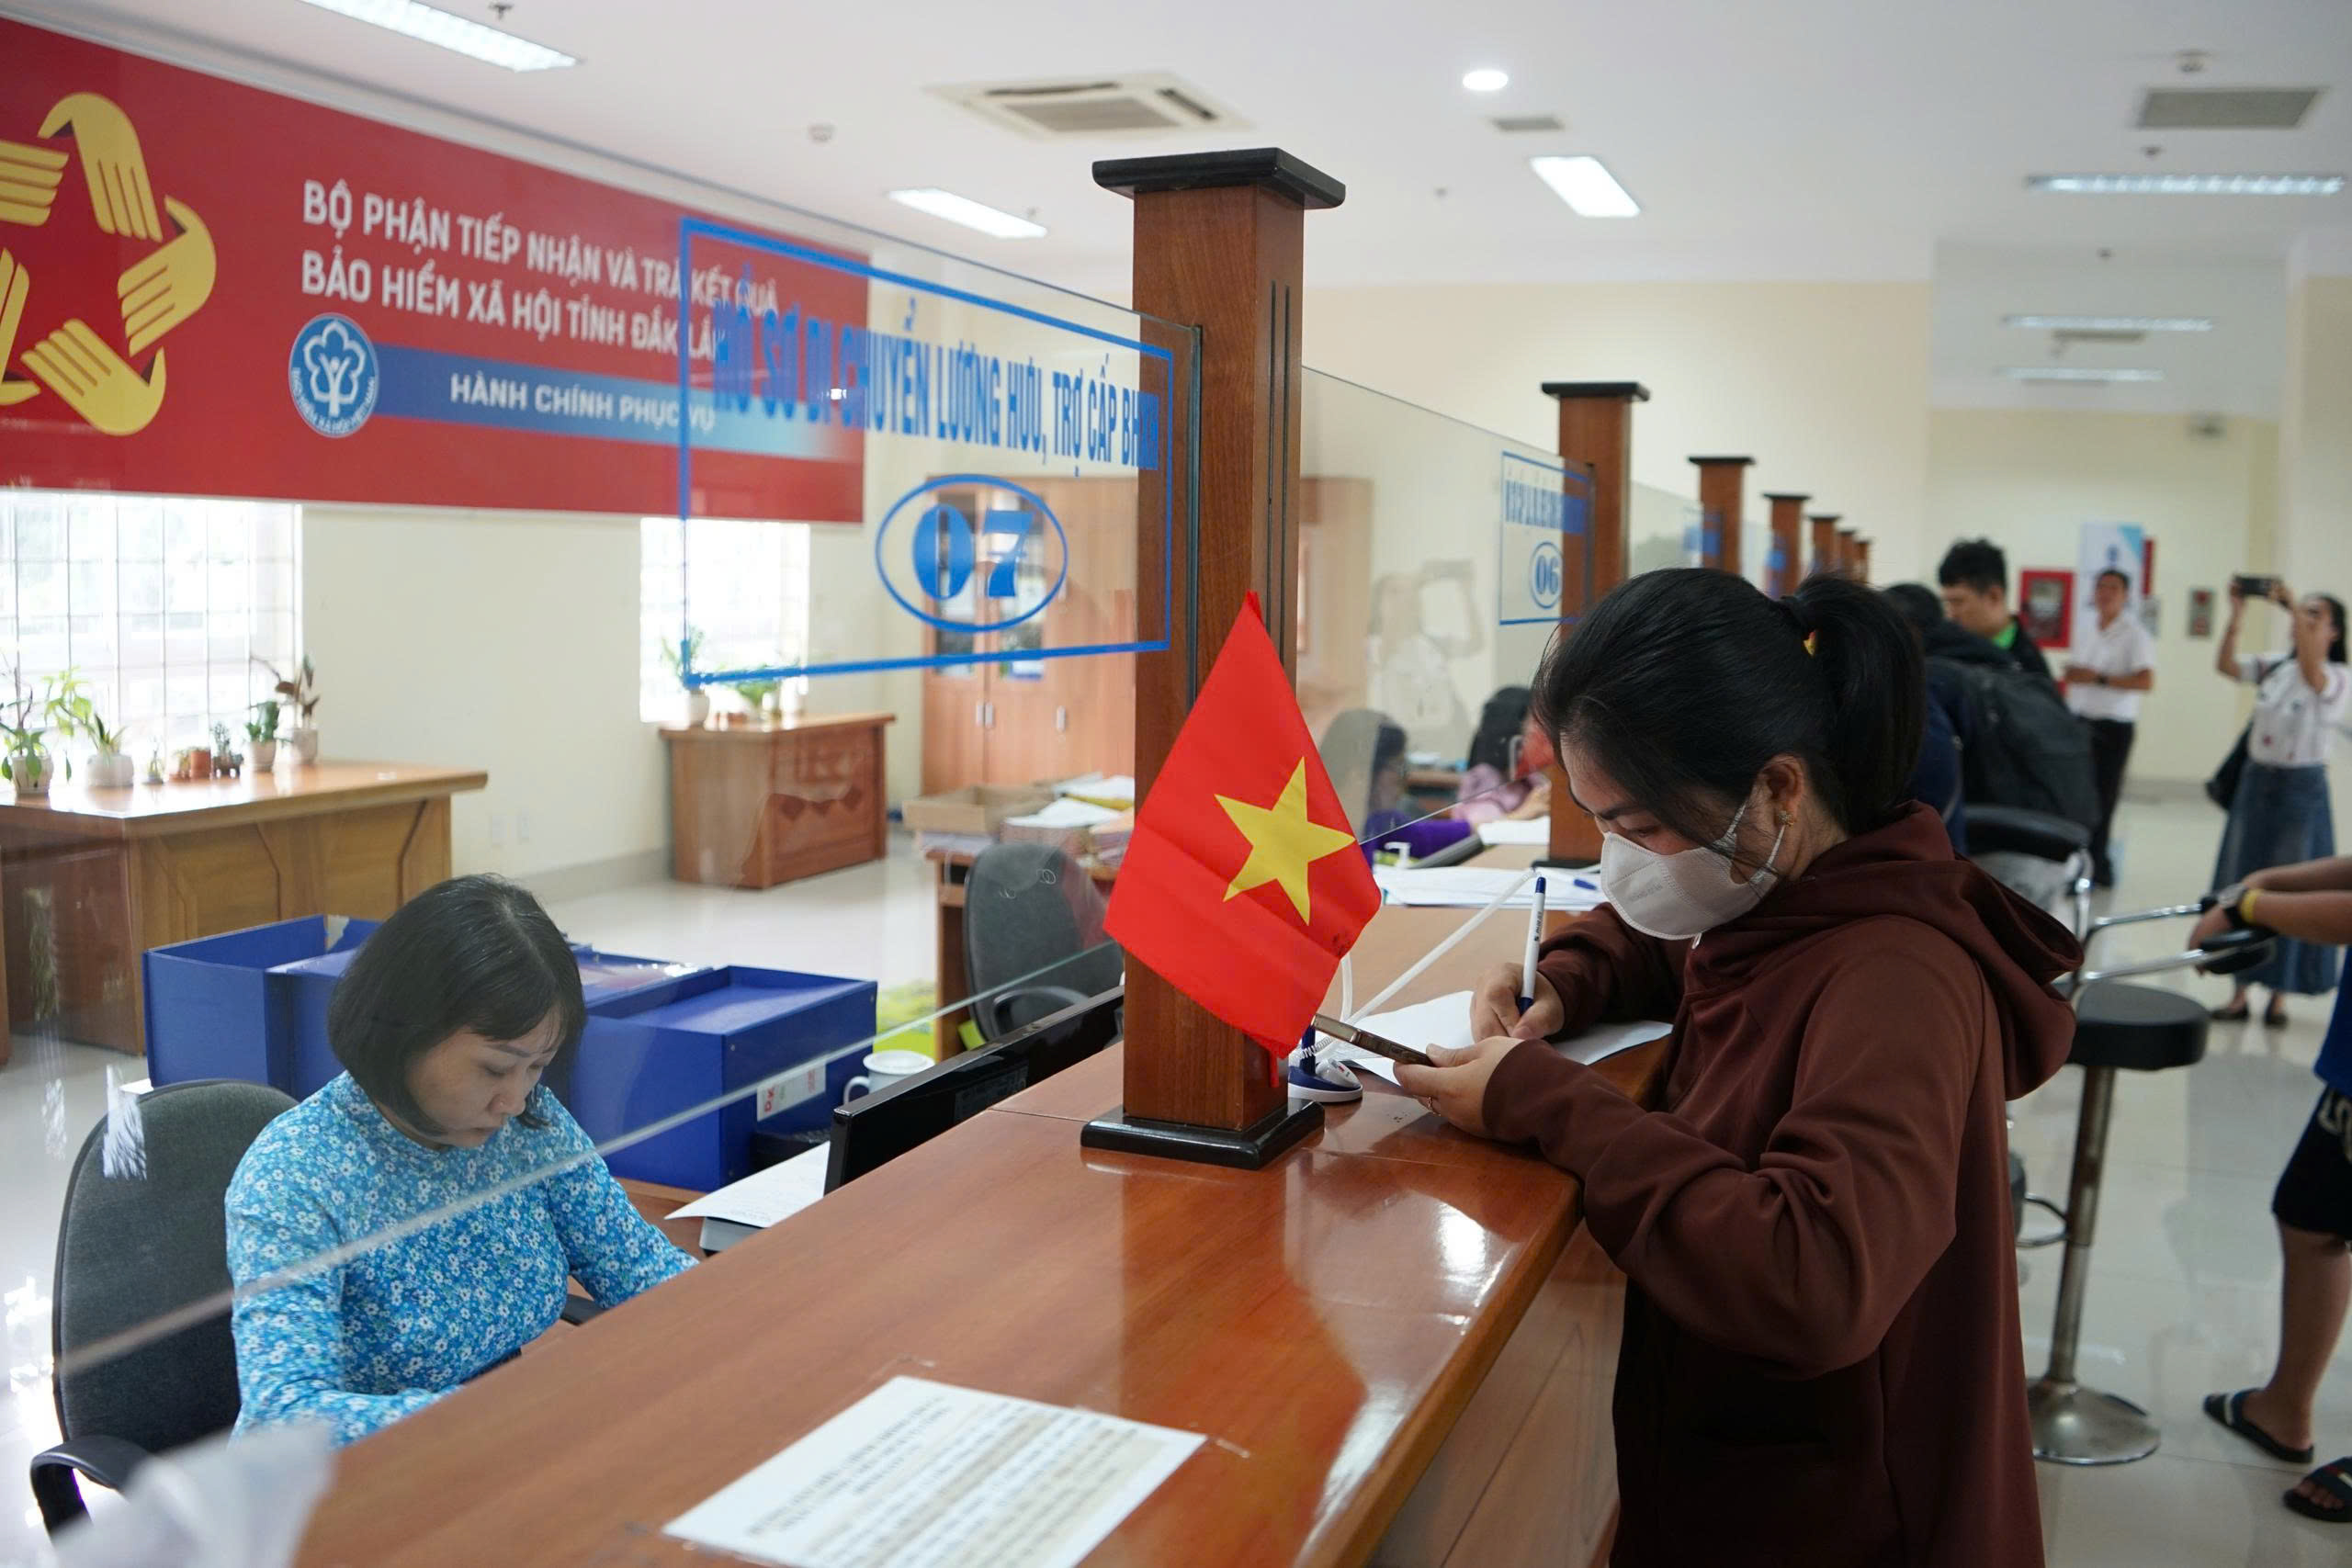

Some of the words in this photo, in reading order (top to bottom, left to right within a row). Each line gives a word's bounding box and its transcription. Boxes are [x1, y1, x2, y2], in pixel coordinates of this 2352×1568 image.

[303, 178, 353, 240] BỘ
[363, 191, 450, 255] PHẬN
[457, 211, 521, 265] TIẾP
[526, 231, 602, 288] NHẬN
[605, 245, 640, 292] VÀ
[301, 244, 372, 303] BẢO
[381, 258, 460, 319] HIỂM
[466, 277, 506, 328] XÃ
[512, 288, 561, 343] HỘI
[566, 293, 626, 346] TỈNH
[449, 369, 528, 412] HÀNH
[534, 383, 614, 420] CHÍNH
[618, 393, 680, 430] PHỤC
[688, 404, 716, 435] VỤ
[937, 339, 1001, 446] LƯƠNG
[1052, 367, 1084, 478] TRỢ
[1088, 352, 1117, 463] CẤP
[912, 502, 1035, 600] 07
[1536, 555, 1559, 595] 06
